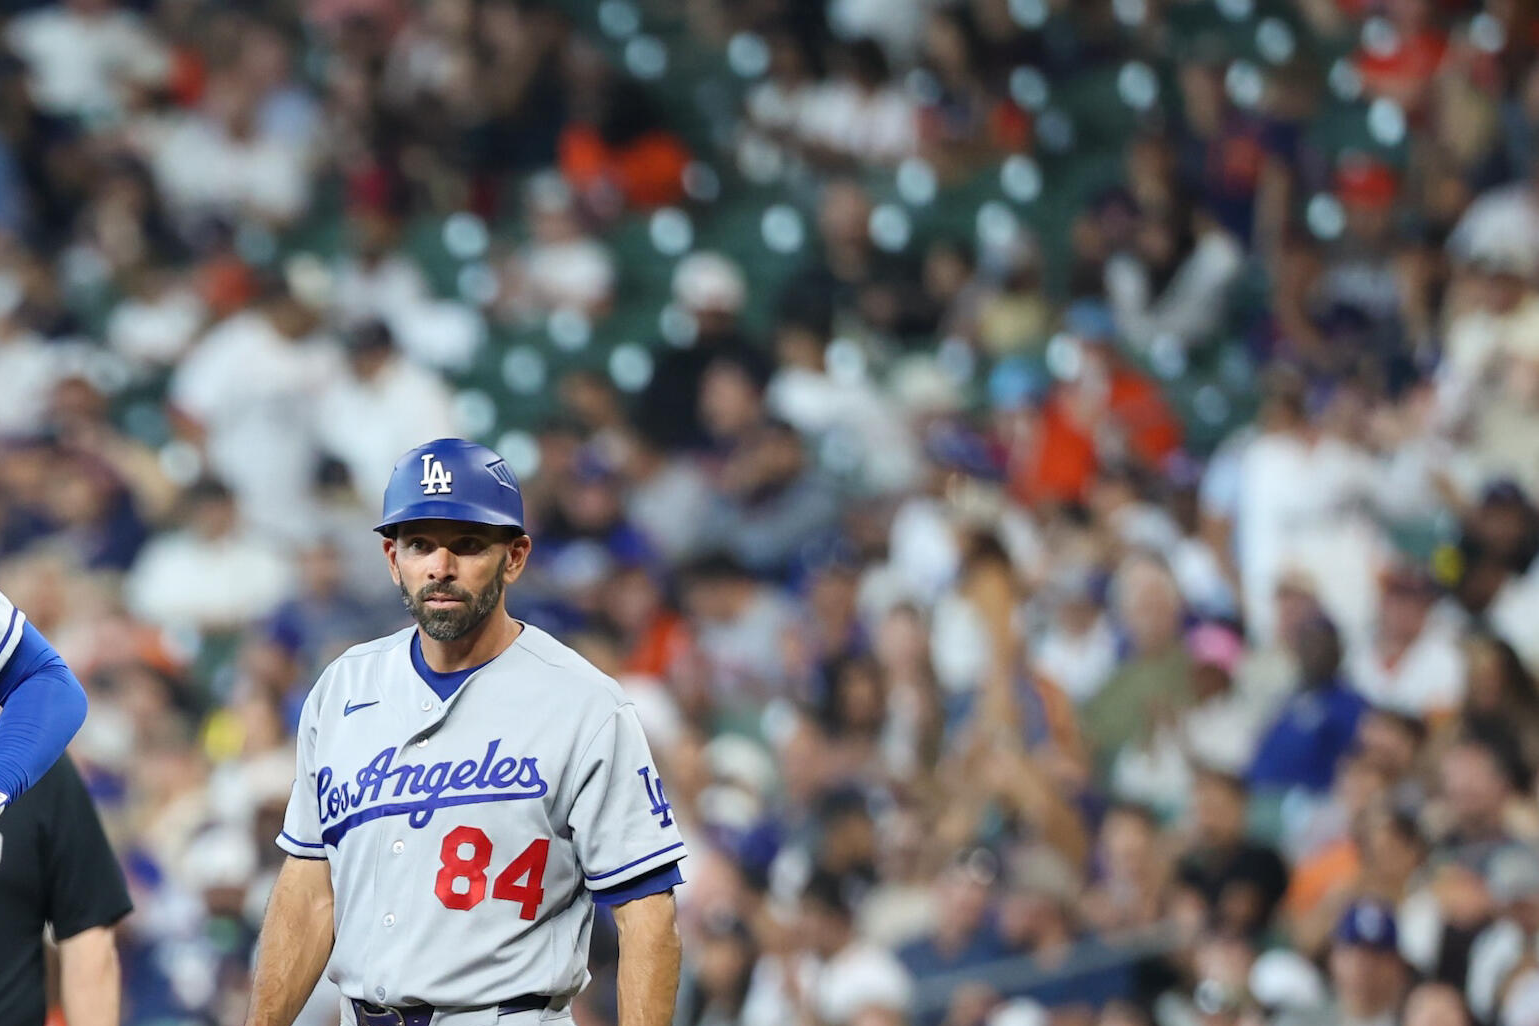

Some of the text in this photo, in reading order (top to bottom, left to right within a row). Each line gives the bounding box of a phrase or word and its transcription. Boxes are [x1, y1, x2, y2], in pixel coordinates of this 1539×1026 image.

[420, 453, 452, 495] LA
[317, 738, 548, 829] Los Angeles
[434, 825, 550, 920] 84
